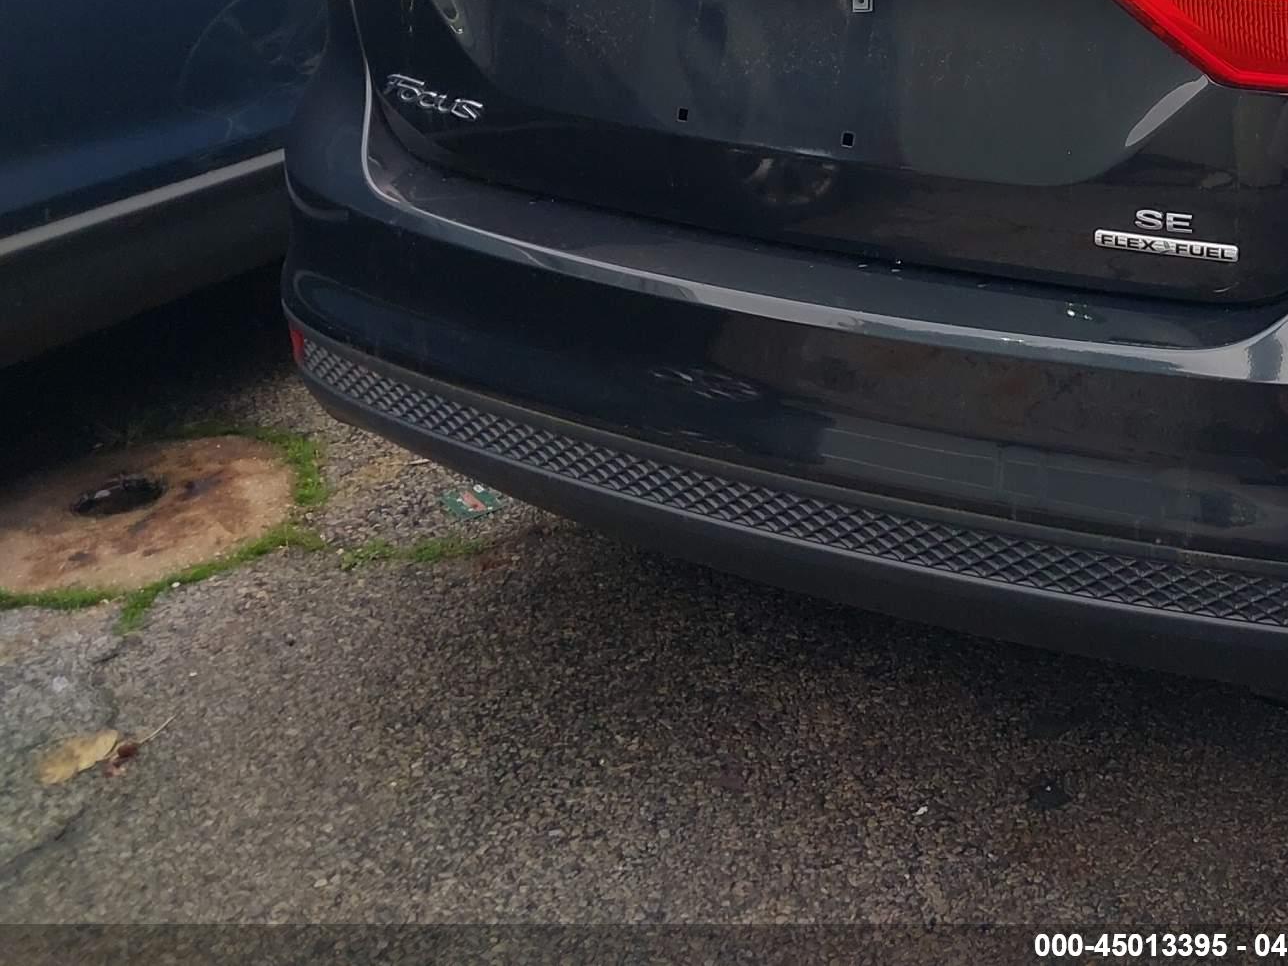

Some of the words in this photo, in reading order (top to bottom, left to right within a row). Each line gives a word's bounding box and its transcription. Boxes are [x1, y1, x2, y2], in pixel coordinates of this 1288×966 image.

[1134, 209, 1193, 234] SE
[1100, 234, 1157, 251] FLEX
[1175, 243, 1234, 260] FUEL
